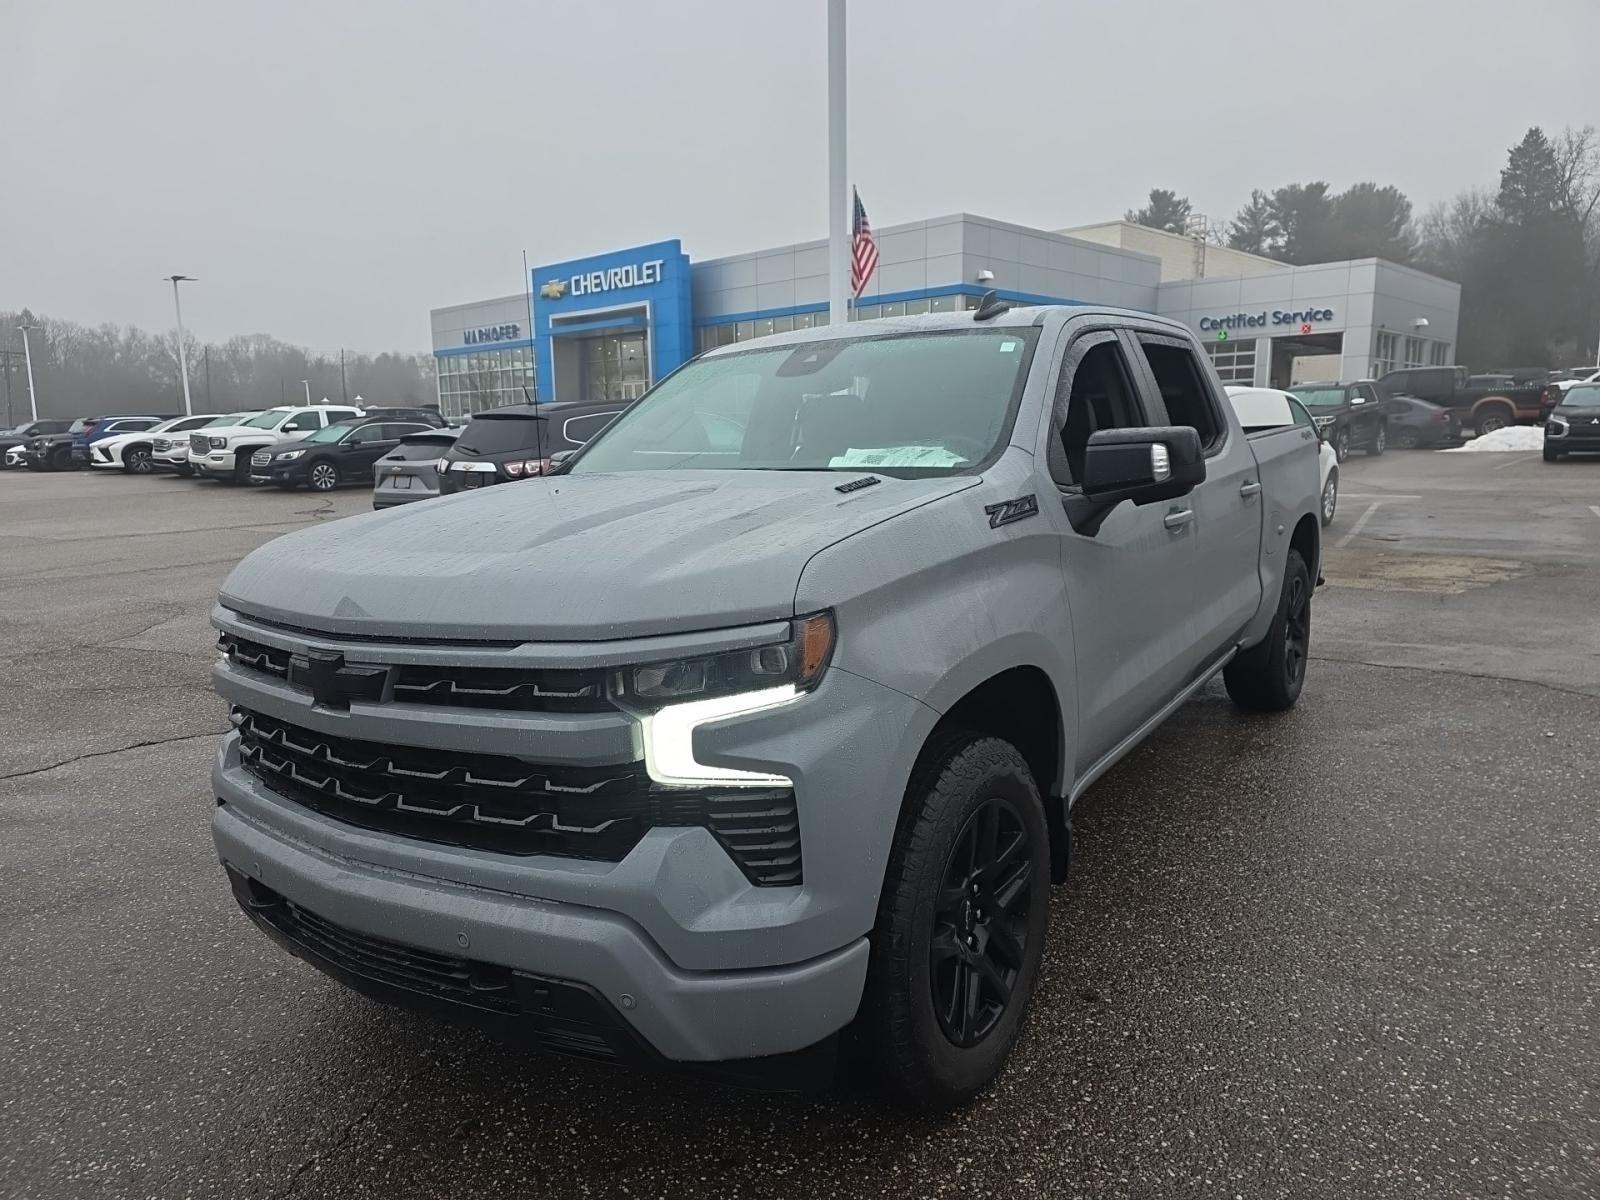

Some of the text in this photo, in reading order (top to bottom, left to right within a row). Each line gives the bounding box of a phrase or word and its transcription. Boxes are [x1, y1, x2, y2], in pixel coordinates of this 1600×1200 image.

[571, 259, 665, 296] CHEVROLET
[1199, 308, 1333, 331] Certified Service
